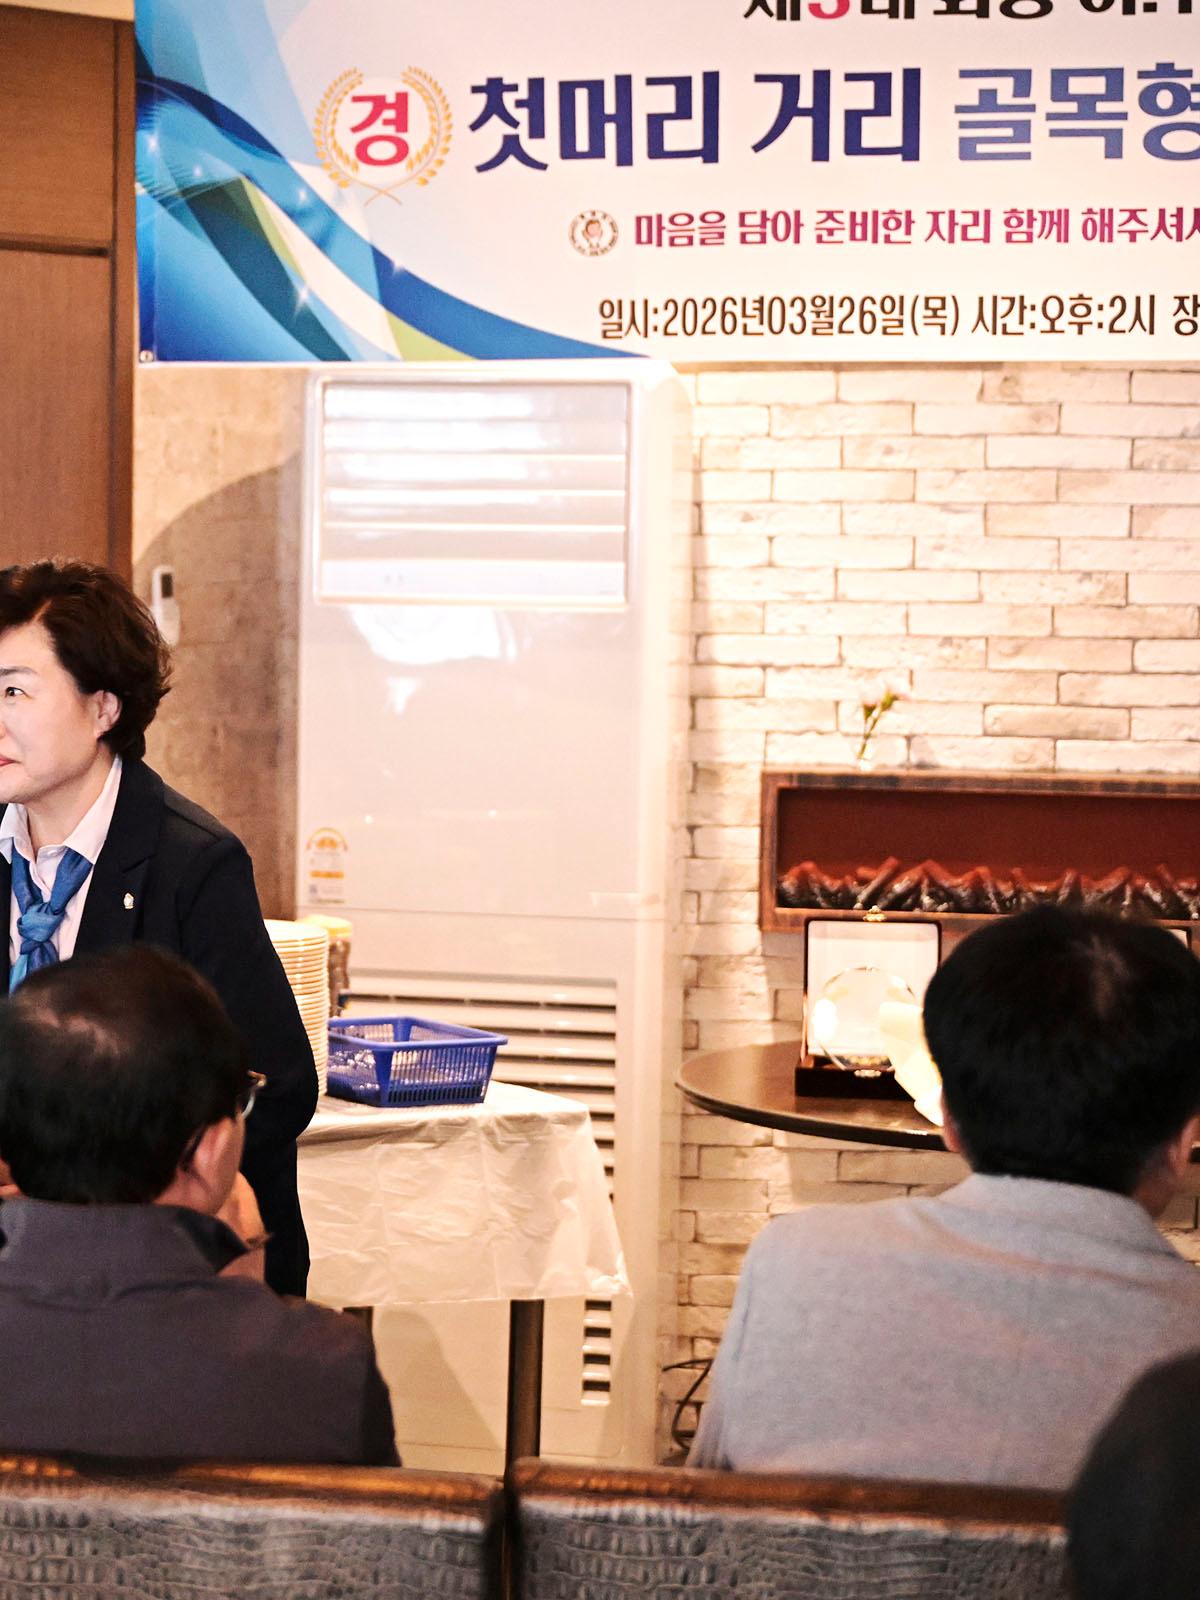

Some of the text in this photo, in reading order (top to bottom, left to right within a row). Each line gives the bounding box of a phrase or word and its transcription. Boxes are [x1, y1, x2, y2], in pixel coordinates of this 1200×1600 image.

[349, 62, 1200, 173] 경 첫머리 거리 골목형
[634, 210, 726, 248] 마음을
[738, 209, 804, 245] 담아
[814, 208, 915, 245] 준비한
[924, 208, 992, 244] 자리
[1003, 207, 1070, 244] 함께
[599, 293, 1200, 340] 일시:2026년03월26일(목) 시간:오후:2시 장
